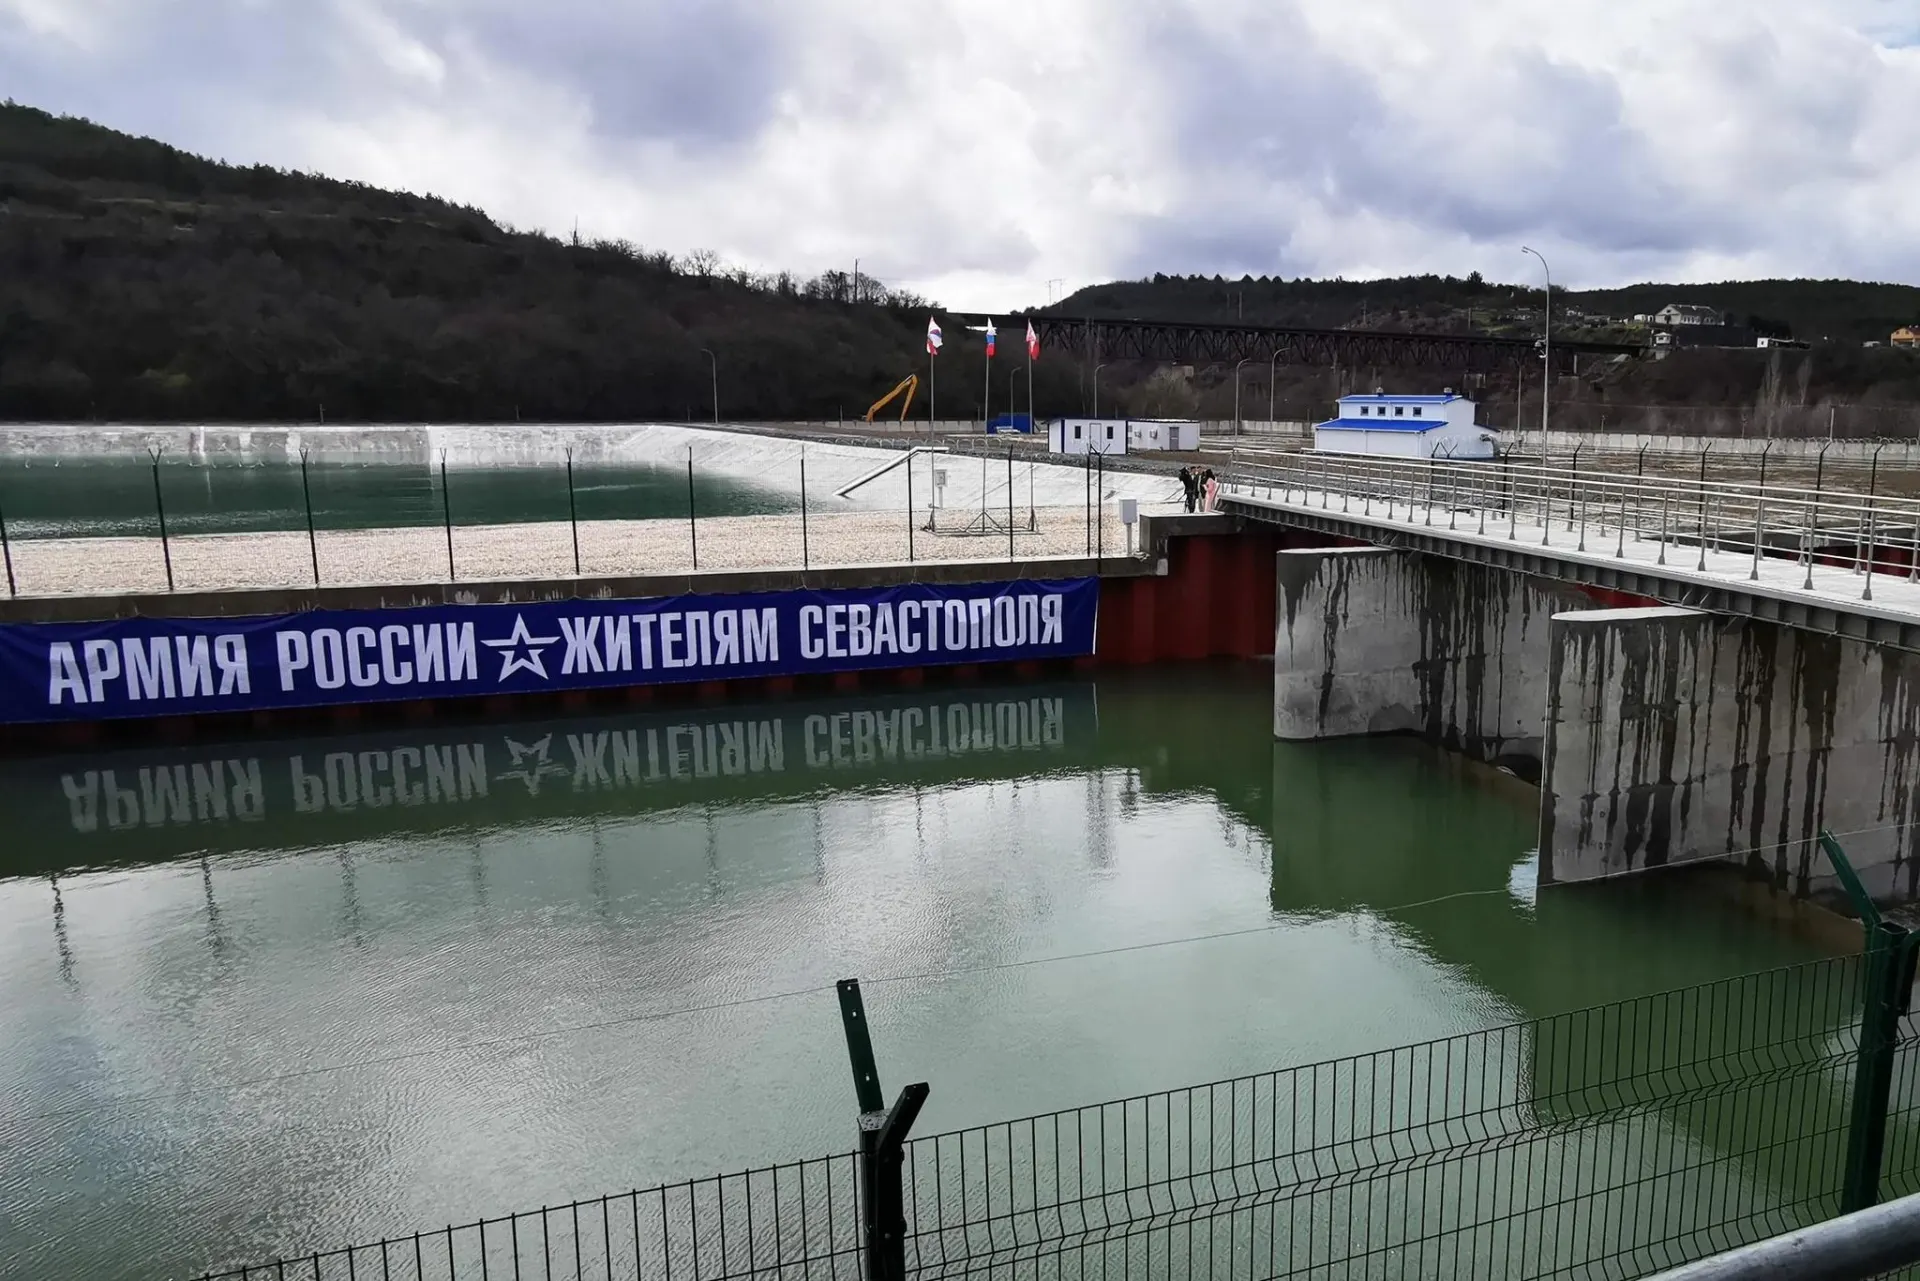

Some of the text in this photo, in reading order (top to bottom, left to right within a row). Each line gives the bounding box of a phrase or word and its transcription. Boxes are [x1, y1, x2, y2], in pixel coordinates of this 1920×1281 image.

[49, 594, 1063, 705] АРМИЯ РОССИИ ЖИТЕЛЯМ СЕВАСТОПОЛЯ
